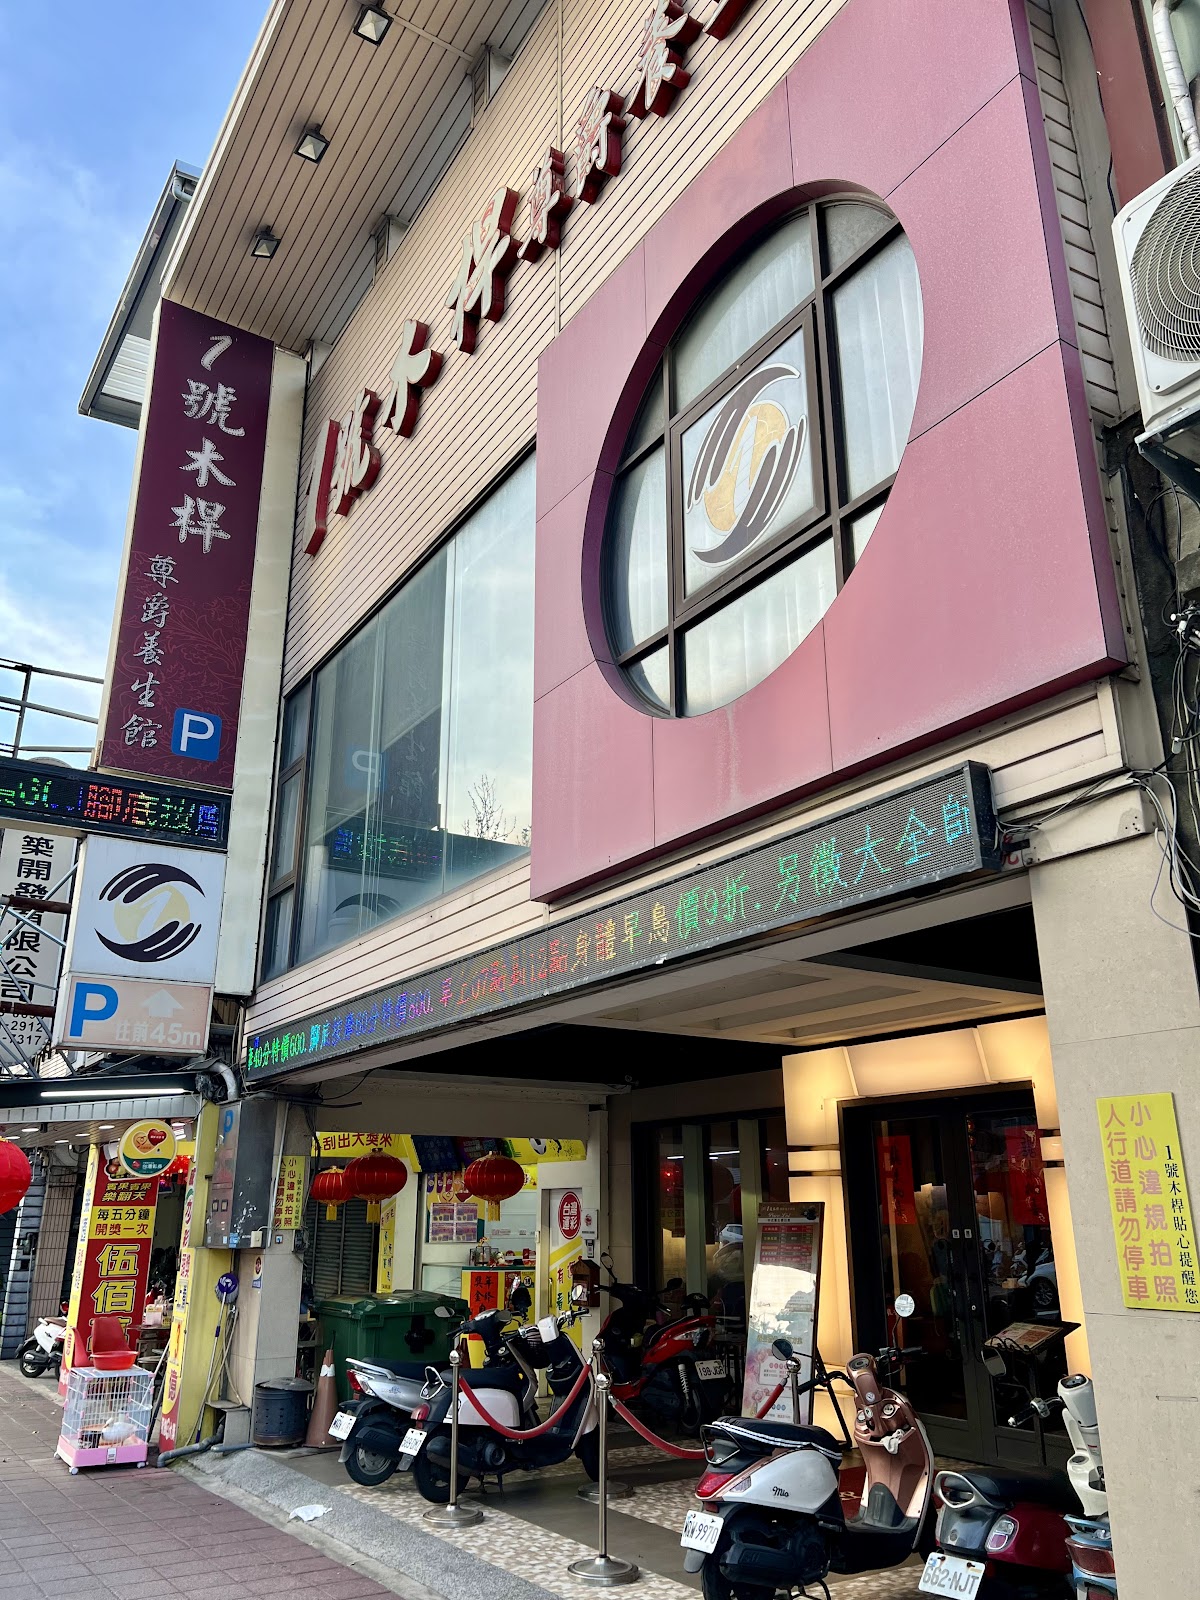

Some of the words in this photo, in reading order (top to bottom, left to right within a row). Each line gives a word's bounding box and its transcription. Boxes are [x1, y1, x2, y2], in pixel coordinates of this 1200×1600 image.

[120, 554, 179, 748] 尊爵養生館
[180, 713, 214, 752] P
[69, 982, 119, 1037] P
[97, 1208, 150, 1221] 每五分鐘
[101, 1191, 146, 1202] 樂翻天
[1104, 1103, 1151, 1302] 人行道請勿停車
[1129, 1101, 1180, 1303] 小心違規拍照
[95, 1223, 149, 1236] 開獎一次
[1164, 1145, 1199, 1305] 1號木桿貼心提醒您
[88, 1243, 141, 1352] 伍佰
[772, 1485, 789, 1498] Mio
